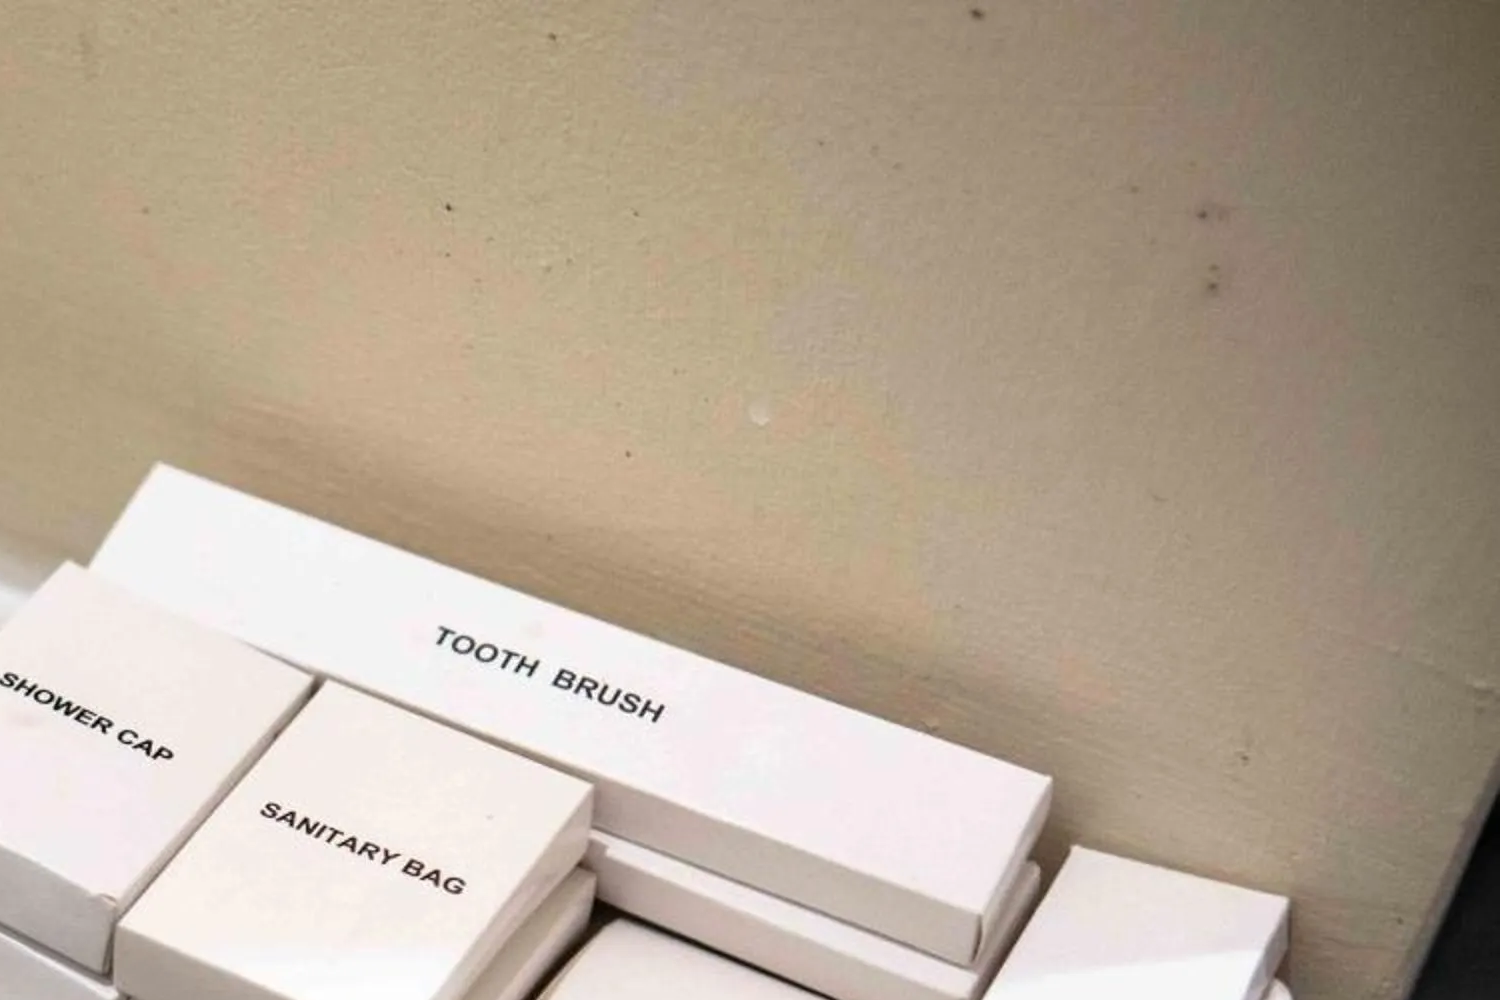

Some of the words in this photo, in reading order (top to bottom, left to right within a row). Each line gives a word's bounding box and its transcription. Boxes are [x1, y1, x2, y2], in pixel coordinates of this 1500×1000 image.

[436, 626, 541, 679] TOOTH
[552, 668, 666, 724] BRUSH
[117, 729, 175, 764] CAP
[260, 802, 402, 866] SANITARY
[401, 858, 468, 896] BAG
